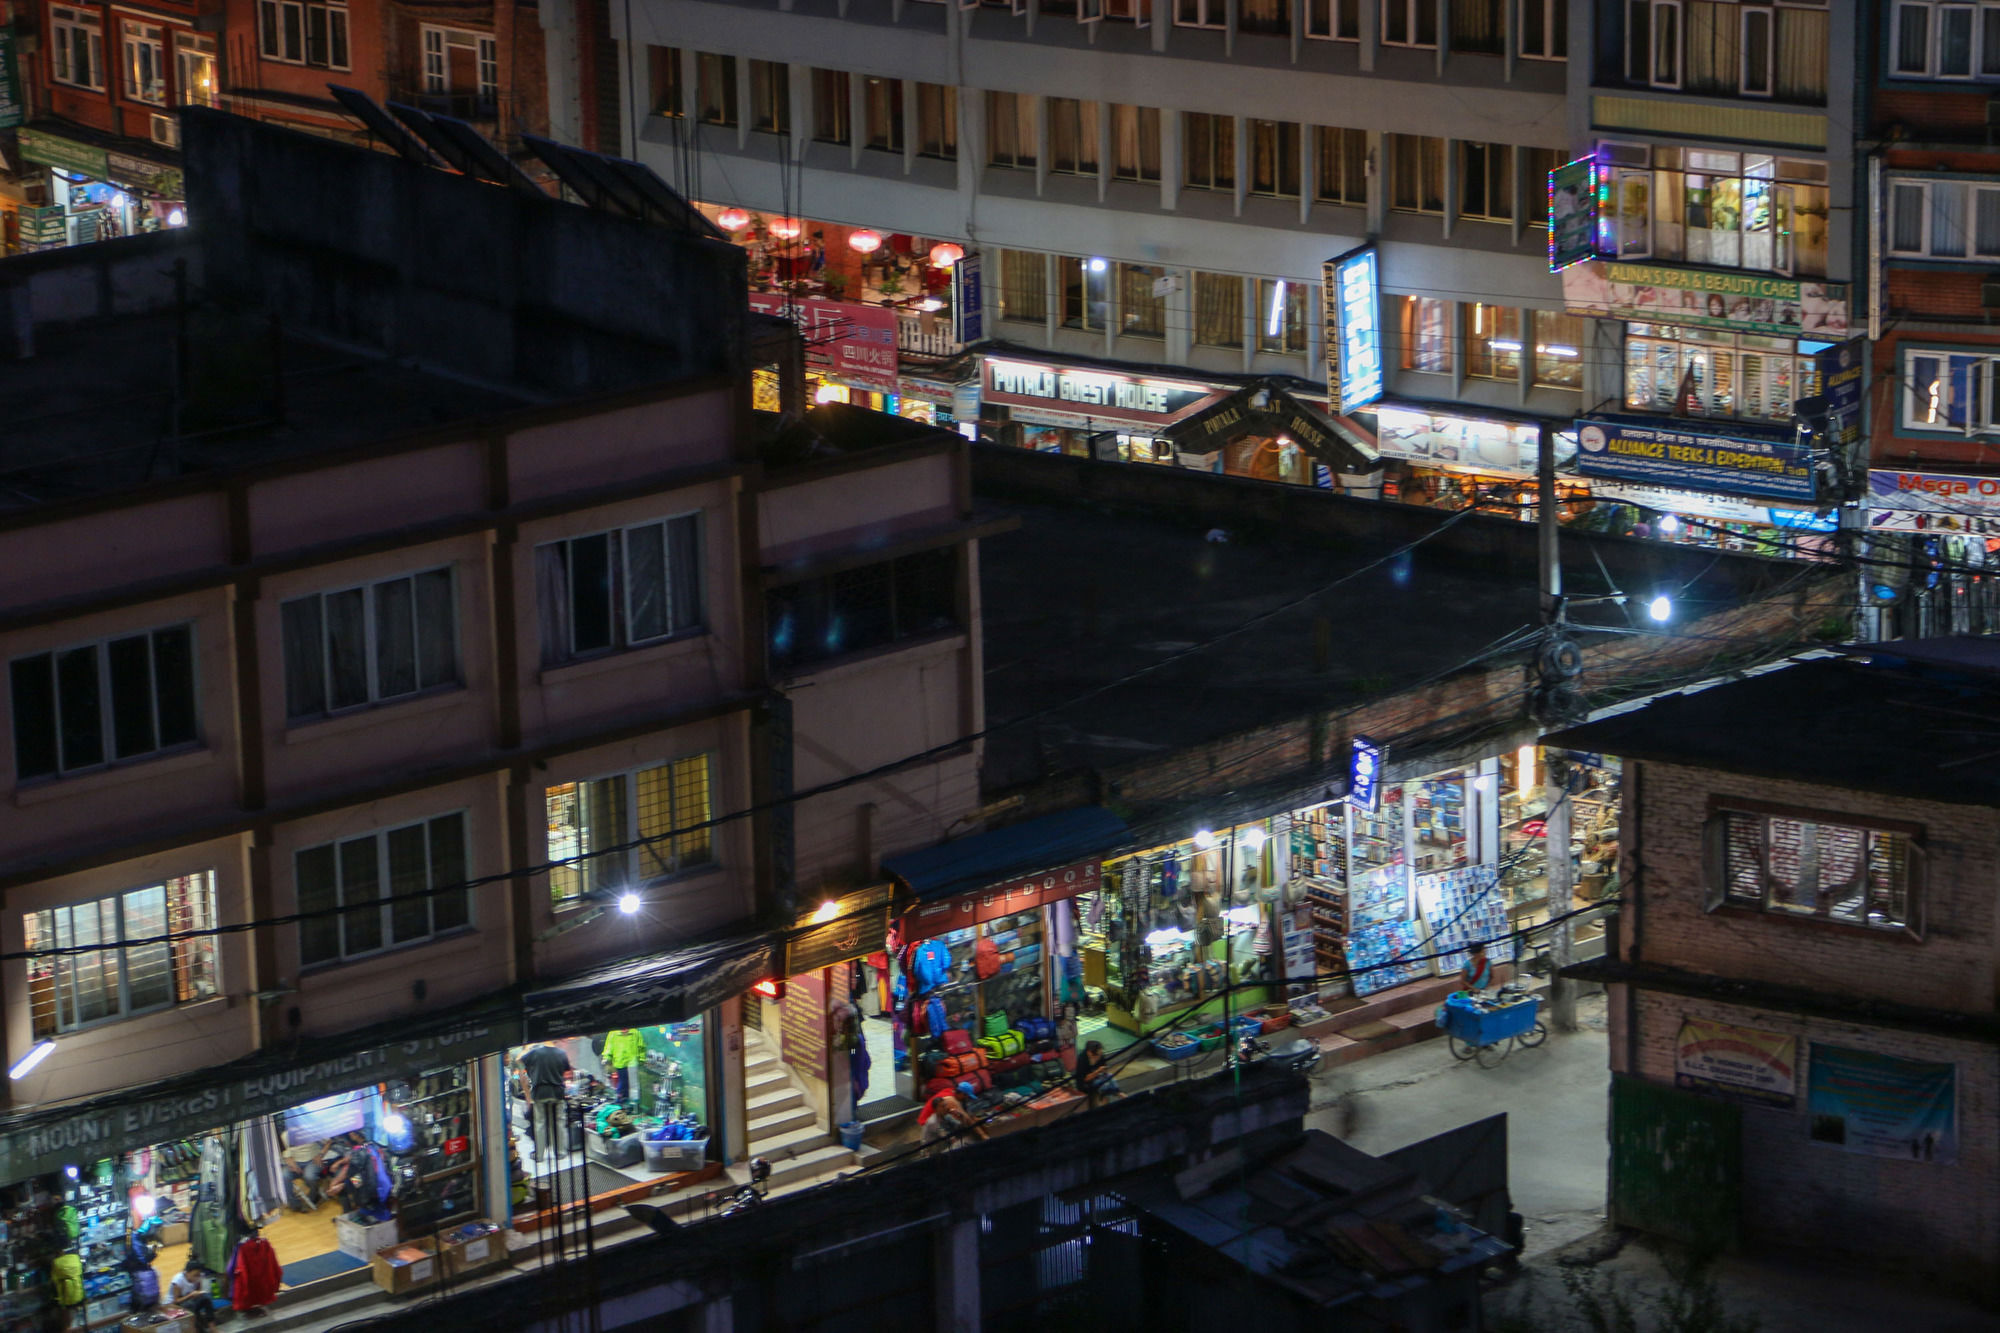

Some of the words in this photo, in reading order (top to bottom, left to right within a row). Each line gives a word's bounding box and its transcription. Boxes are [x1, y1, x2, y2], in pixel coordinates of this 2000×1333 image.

[1609, 265, 1662, 284] ALINA'S
[1664, 270, 1690, 287] SPA
[1693, 273, 1703, 288] &
[1706, 274, 1757, 293] BEAUTY
[1761, 280, 1798, 298] CARE
[993, 366, 1056, 398] POTALA
[1058, 374, 1112, 406] GUEST
[1115, 382, 1168, 413] HOUSE
[1290, 415, 1327, 448] HOUSE
[1608, 438, 1665, 458] ALLIANCE
[1667, 445, 1704, 463] TREKS
[1897, 474, 1970, 496] Mega
[1977, 479, 2000, 496] O
[961, 864, 1096, 912] OUTDOOR
[28, 1115, 113, 1160] MOUNT
[123, 1087, 233, 1132] EVEREST
[243, 1048, 389, 1099] EQUIPMENT
